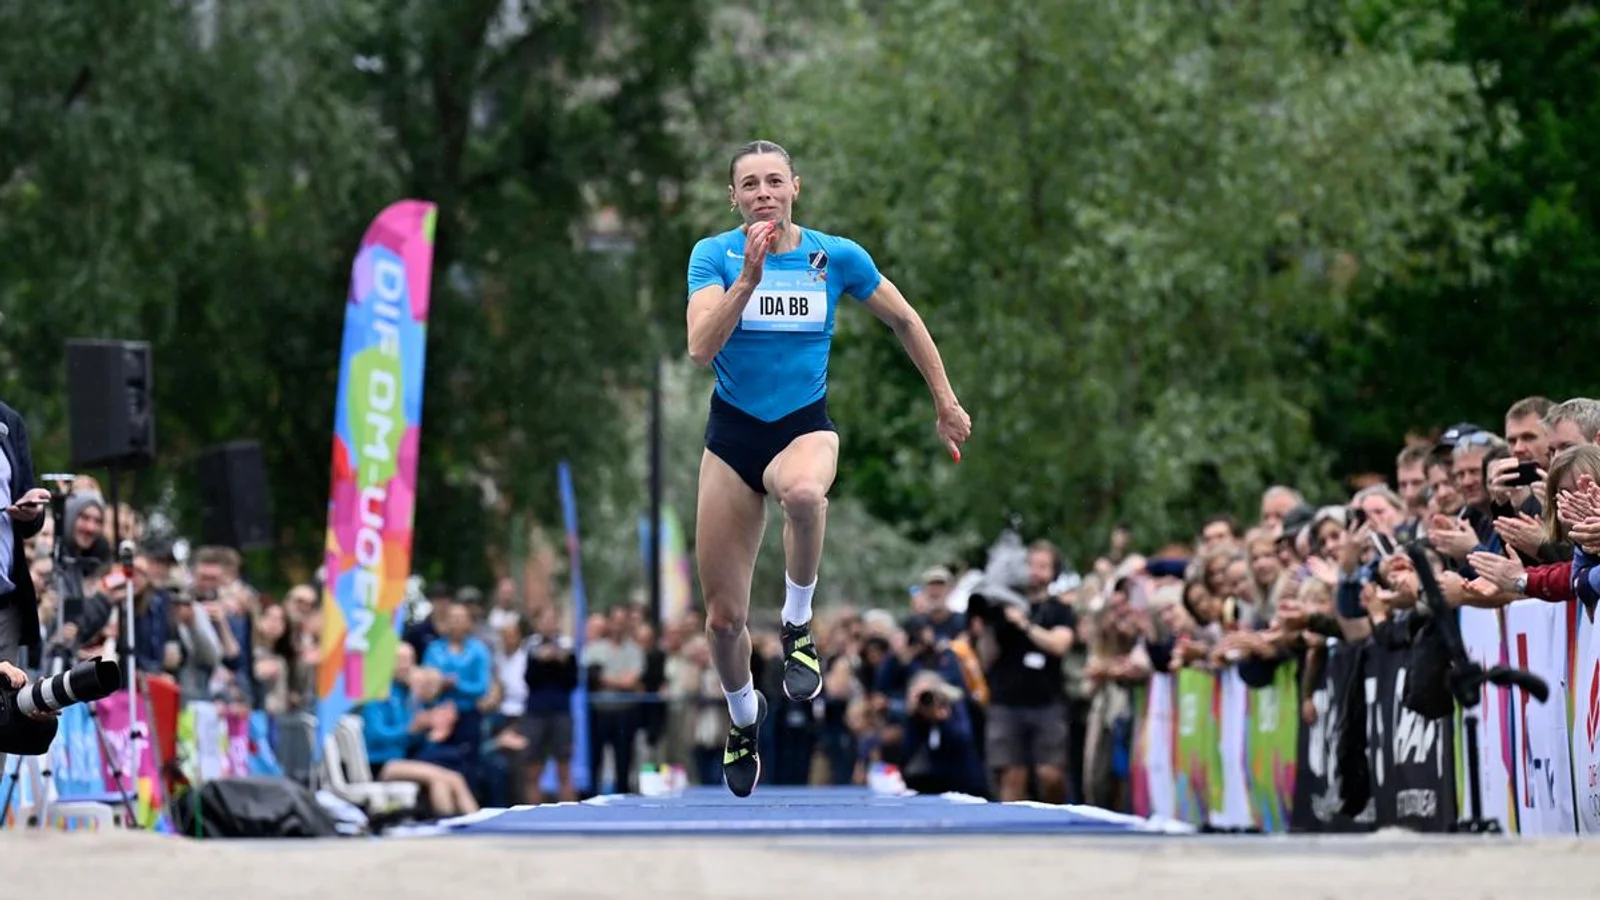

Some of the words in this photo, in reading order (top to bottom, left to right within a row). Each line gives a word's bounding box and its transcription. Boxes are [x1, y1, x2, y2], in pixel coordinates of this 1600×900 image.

[372, 259, 405, 358] DIF
[759, 296, 785, 316] IDA
[789, 297, 809, 316] BB
